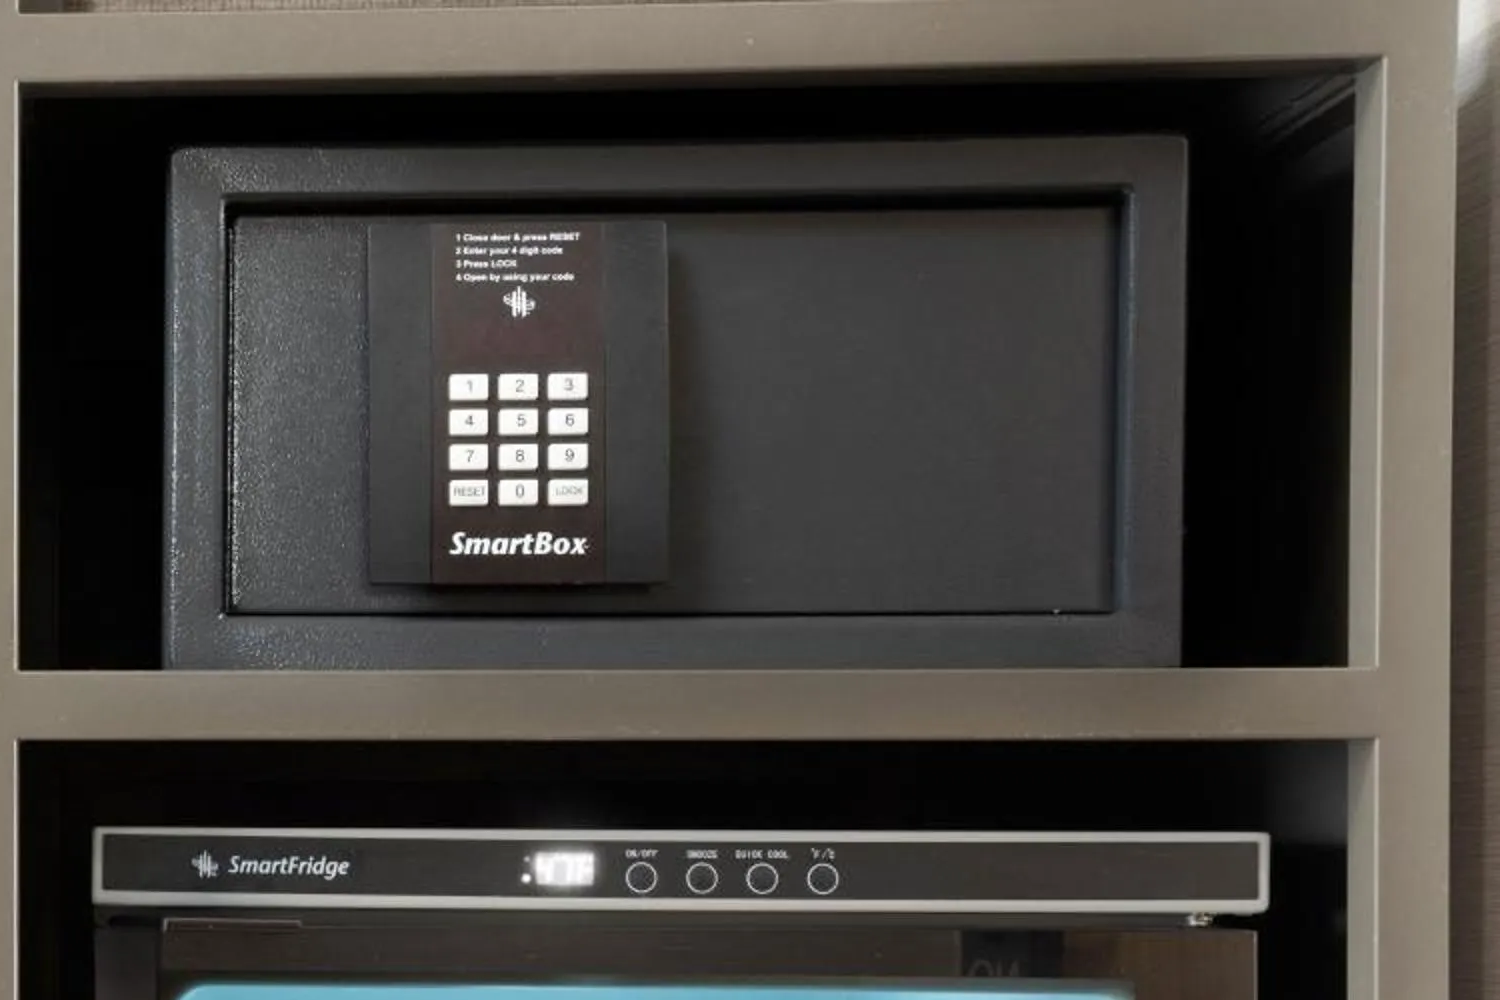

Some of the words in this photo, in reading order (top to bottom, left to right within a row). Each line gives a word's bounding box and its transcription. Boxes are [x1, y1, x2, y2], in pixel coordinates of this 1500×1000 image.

[456, 233, 461, 242] 1
[463, 233, 488, 242] Close
[490, 232, 511, 242] door
[522, 234, 547, 243] press
[549, 232, 580, 241] RESET
[455, 246, 461, 255] 2
[463, 246, 487, 255] Enter
[489, 246, 509, 257] your
[511, 246, 517, 255] 4
[519, 246, 539, 256] digit
[541, 245, 563, 255] code
[463, 259, 489, 268] Press
[491, 259, 517, 268] LOCK
[455, 273, 462, 281] 4
[463, 273, 488, 283] Open
[489, 273, 500, 283] by
[502, 272, 529, 283] using
[530, 274, 551, 283] your
[552, 272, 575, 281] code
[467, 380, 473, 392] 1
[516, 379, 524, 393] 2
[565, 378, 574, 391] 3
[465, 414, 474, 427] 4
[517, 413, 526, 427] 5
[565, 413, 574, 427] 6
[466, 449, 475, 462] 7
[516, 449, 524, 462] 8
[565, 449, 574, 462] 9
[453, 485, 486, 497] RESET
[516, 484, 524, 498] 0
[449, 531, 587, 556] SmartBox
[625, 848, 658, 858] ON/OFF
[767, 849, 789, 859] COOL
[228, 855, 350, 880] SmartFridge
